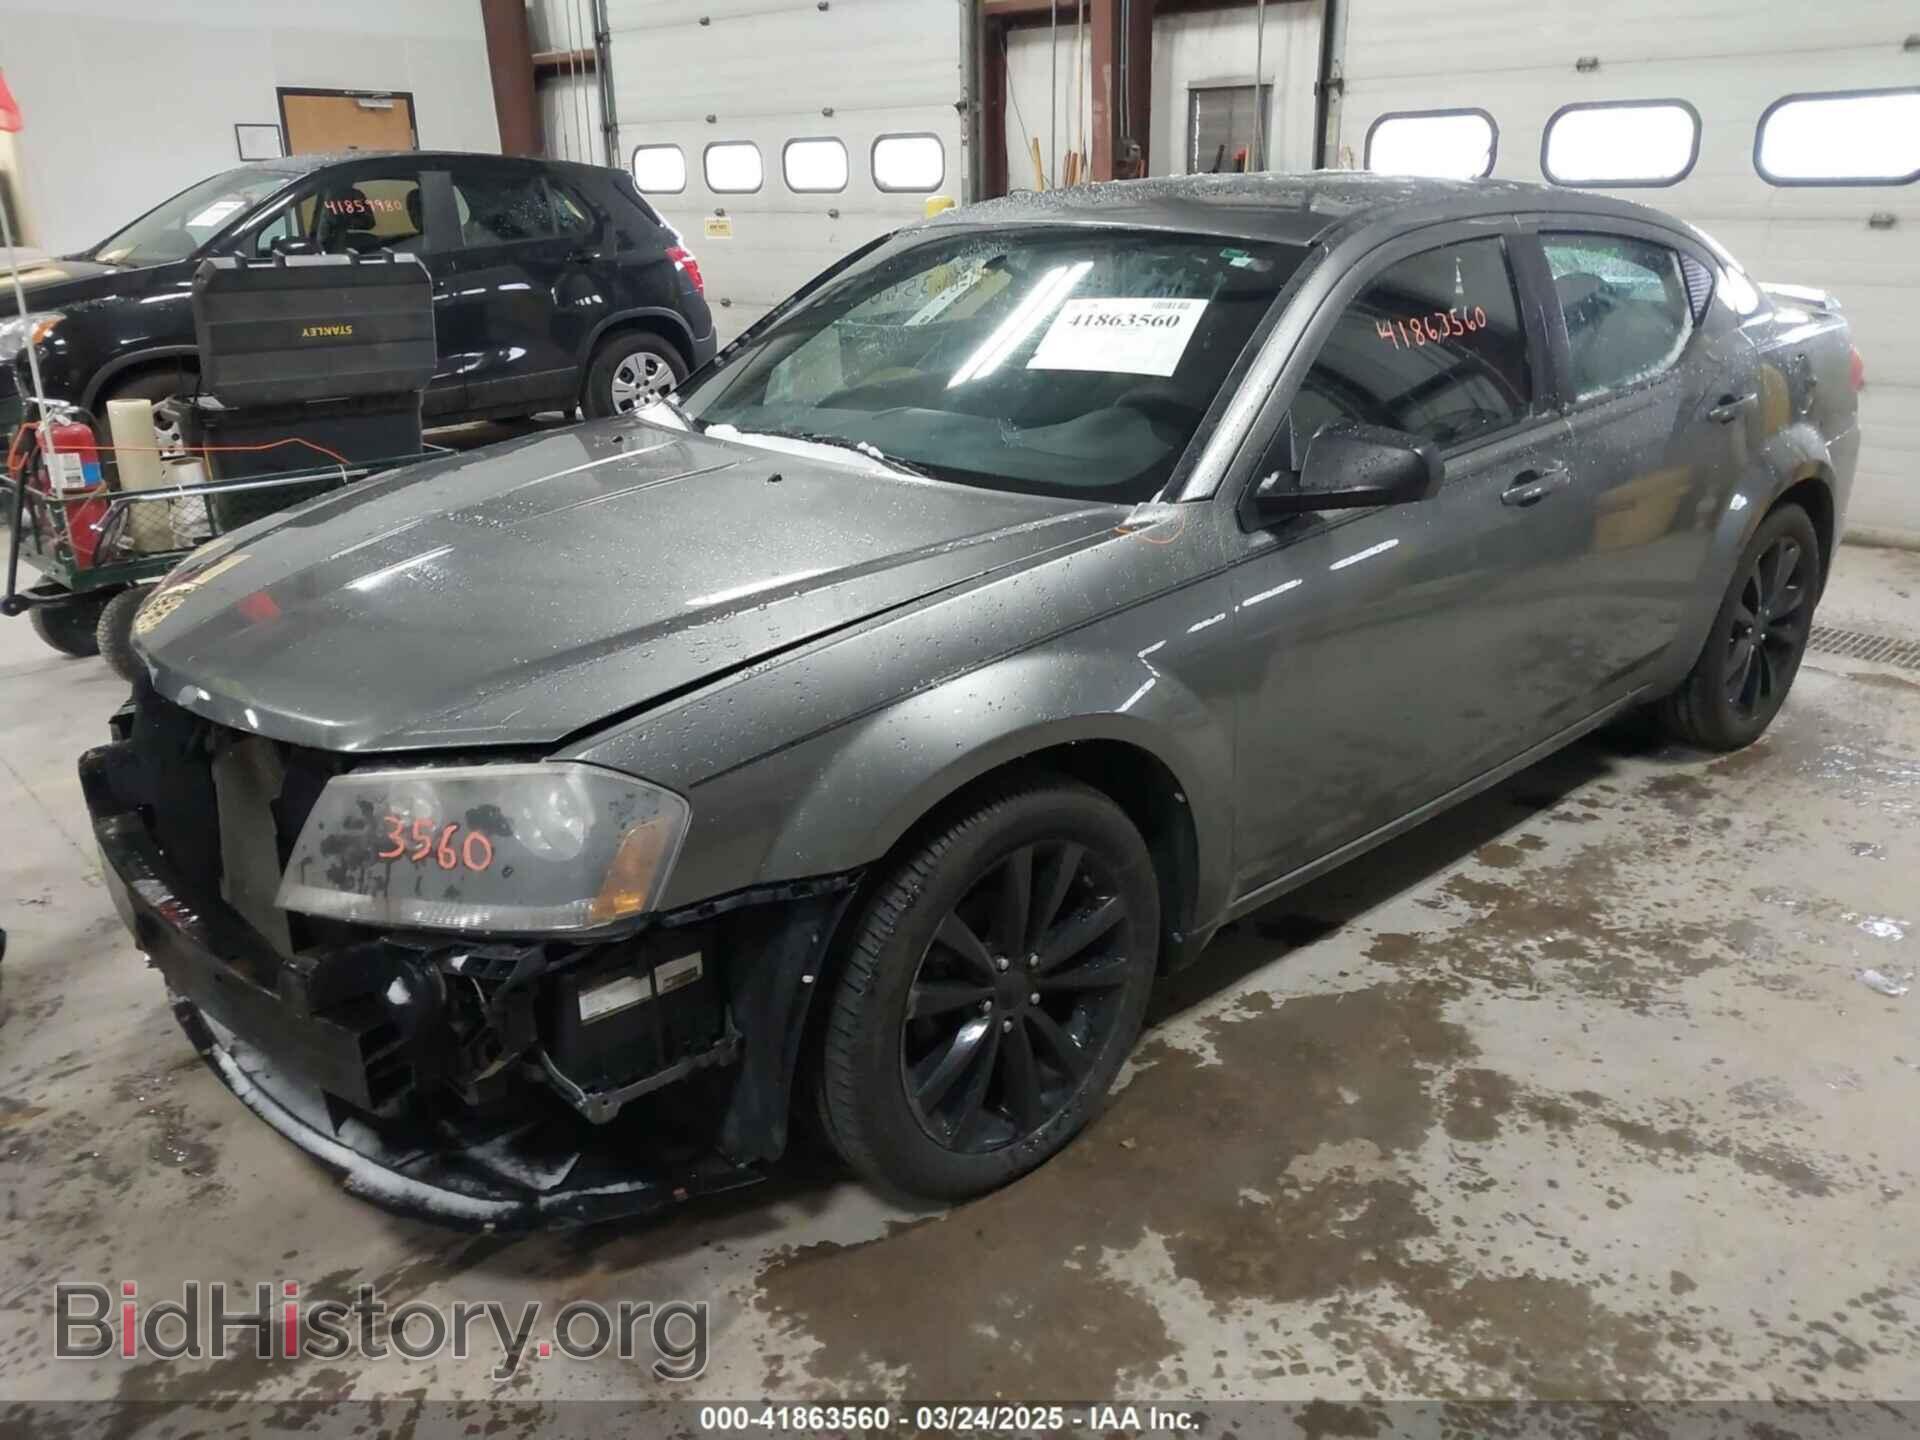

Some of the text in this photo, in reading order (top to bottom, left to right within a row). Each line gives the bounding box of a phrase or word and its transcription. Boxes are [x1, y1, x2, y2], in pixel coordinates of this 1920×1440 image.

[302, 324, 353, 337] STANLEY
[1068, 313, 1181, 329] 41863560
[1376, 305, 1487, 350] 41863560
[378, 815, 493, 871] 3560
